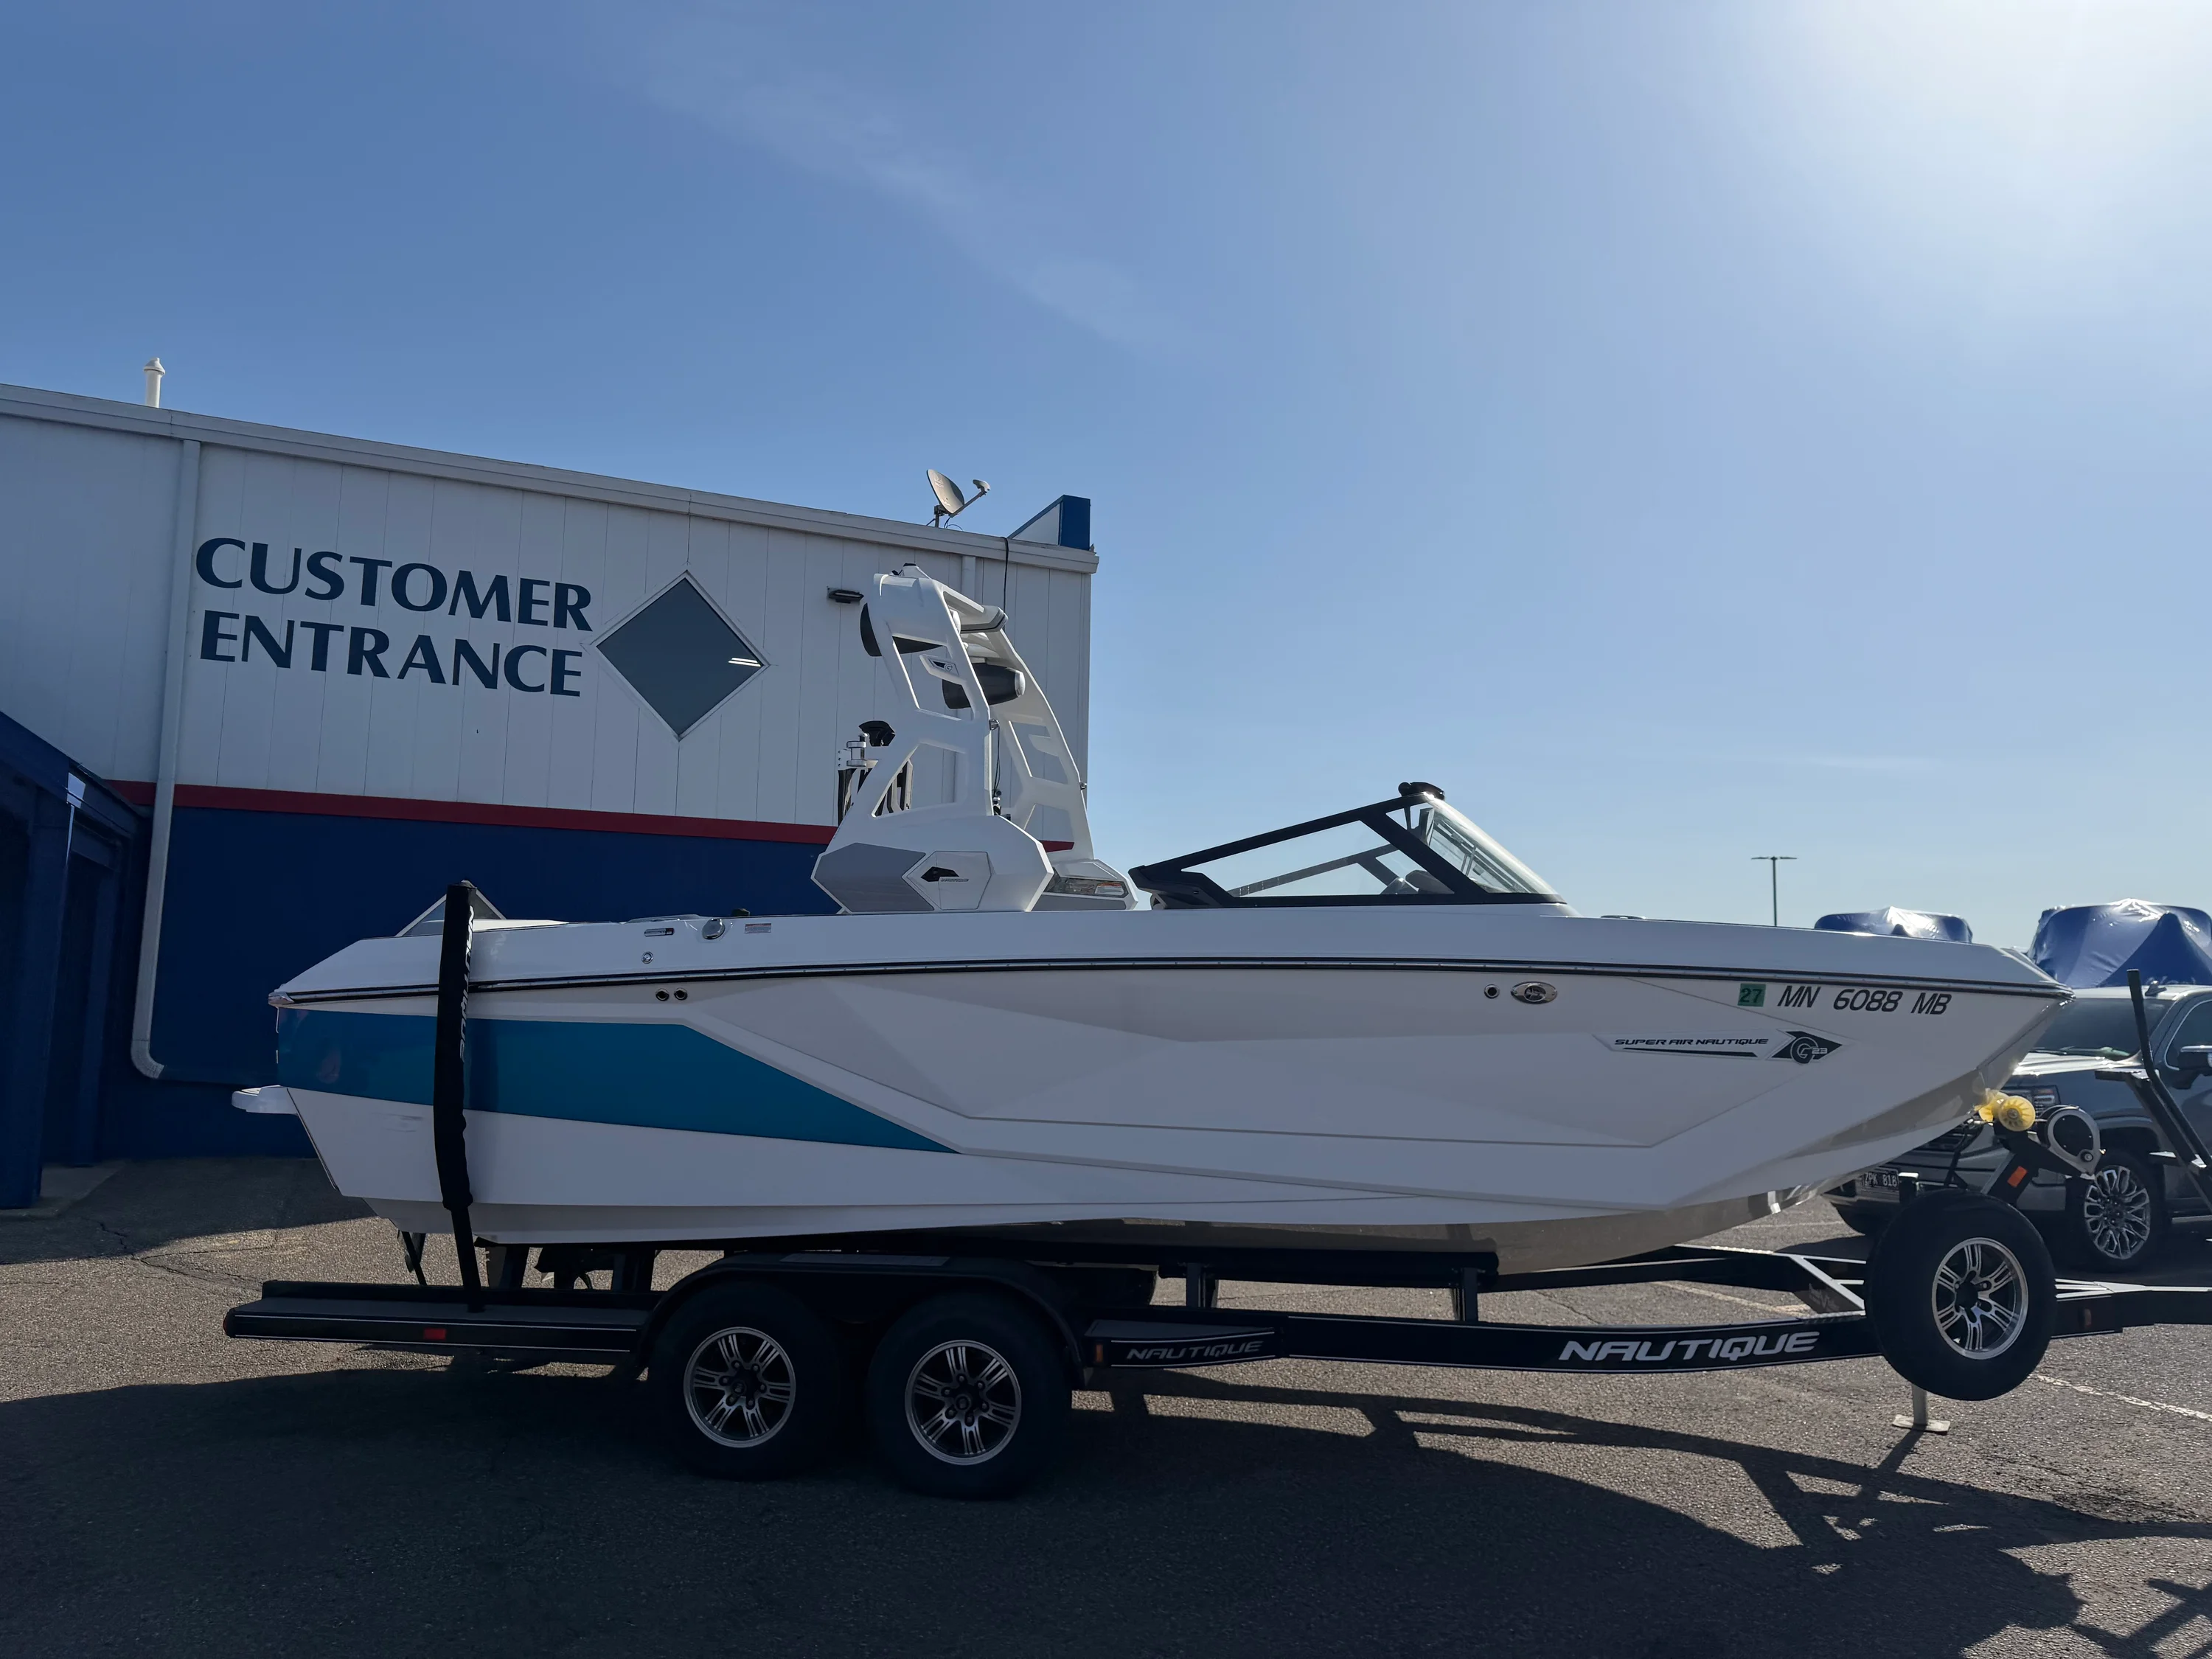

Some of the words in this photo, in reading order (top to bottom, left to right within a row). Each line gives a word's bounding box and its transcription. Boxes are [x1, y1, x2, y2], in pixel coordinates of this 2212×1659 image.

[195, 537, 592, 632] CUSTOMER
[200, 609, 582, 698] ENTRANCE
[1740, 987, 1764, 1004] 27
[1777, 985, 1821, 1008] MN
[1833, 989, 1903, 1012] 6088
[1911, 992, 1952, 1015] MB
[1126, 1340, 1264, 1360] NAUTIQUE
[1559, 1331, 1820, 1361] NAUTIQUE
